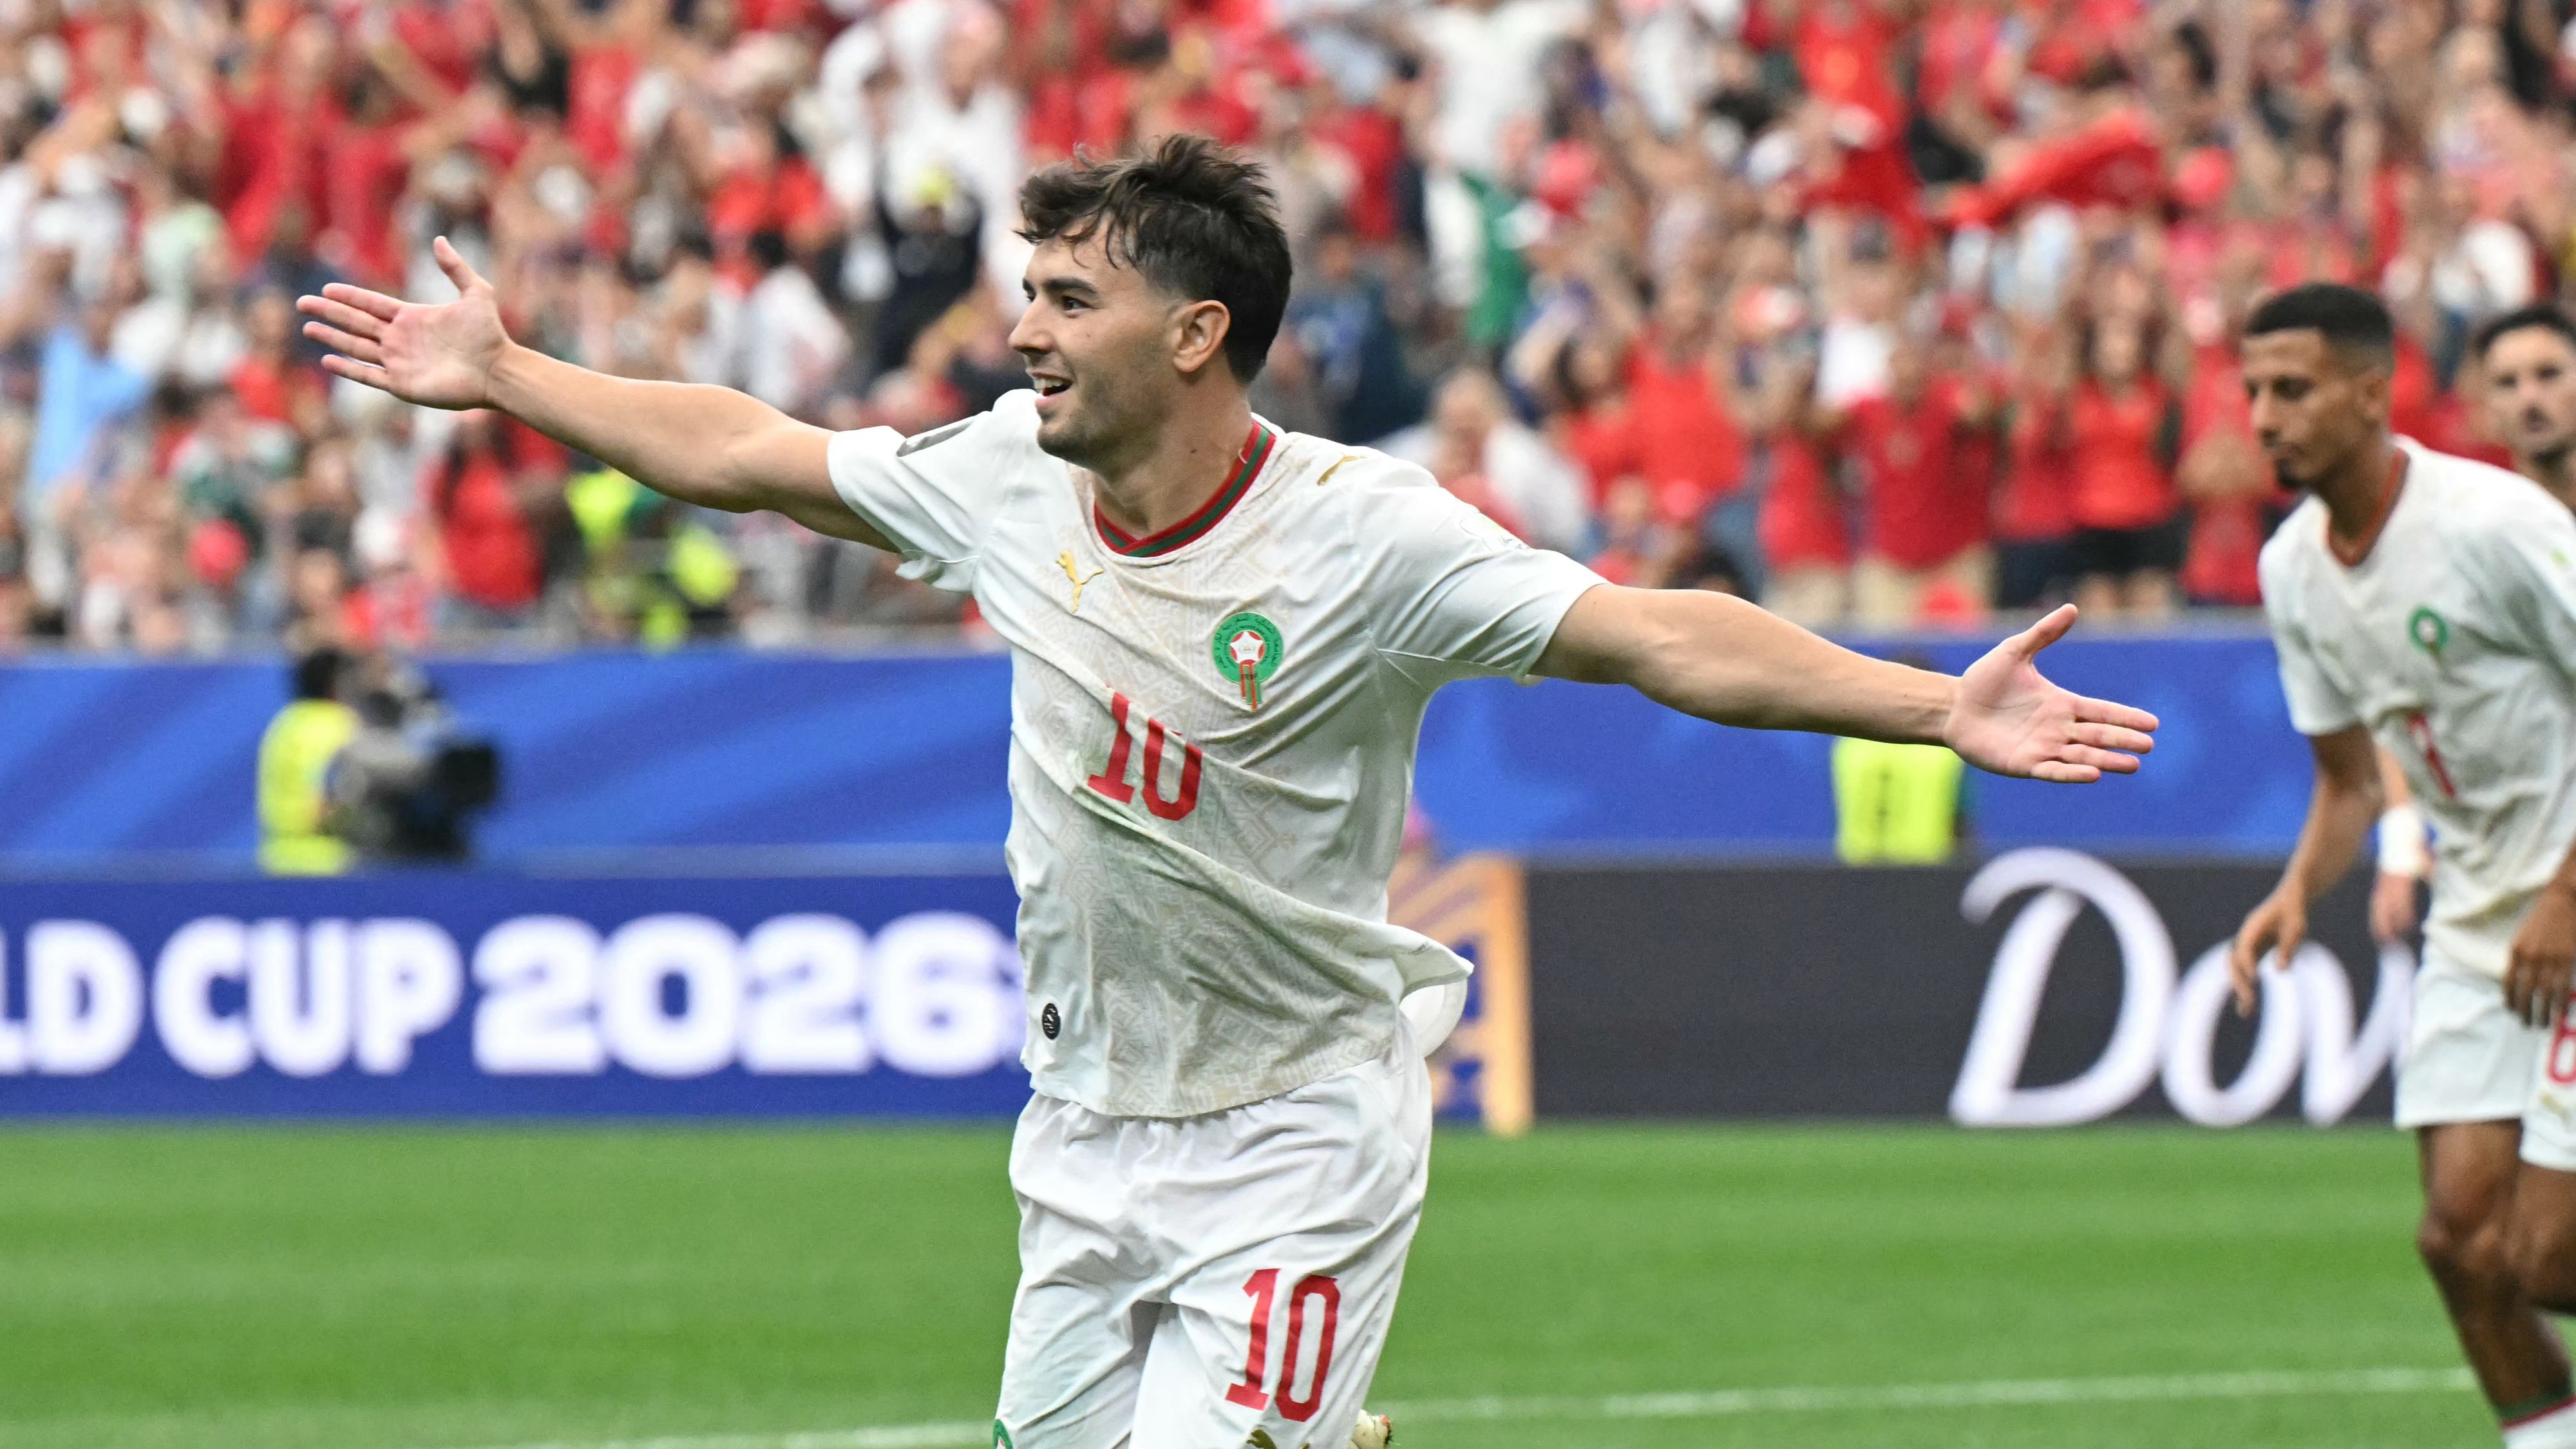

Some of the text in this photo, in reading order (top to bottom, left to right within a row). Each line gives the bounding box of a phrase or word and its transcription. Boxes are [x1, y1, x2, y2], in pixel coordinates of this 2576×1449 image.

[1086, 690, 1203, 822] 10
[152, 917, 462, 1077] CUP
[471, 912, 1011, 1077] 2026
[1949, 846, 2414, 1127] Dov
[1224, 1267, 1341, 1423] 10
